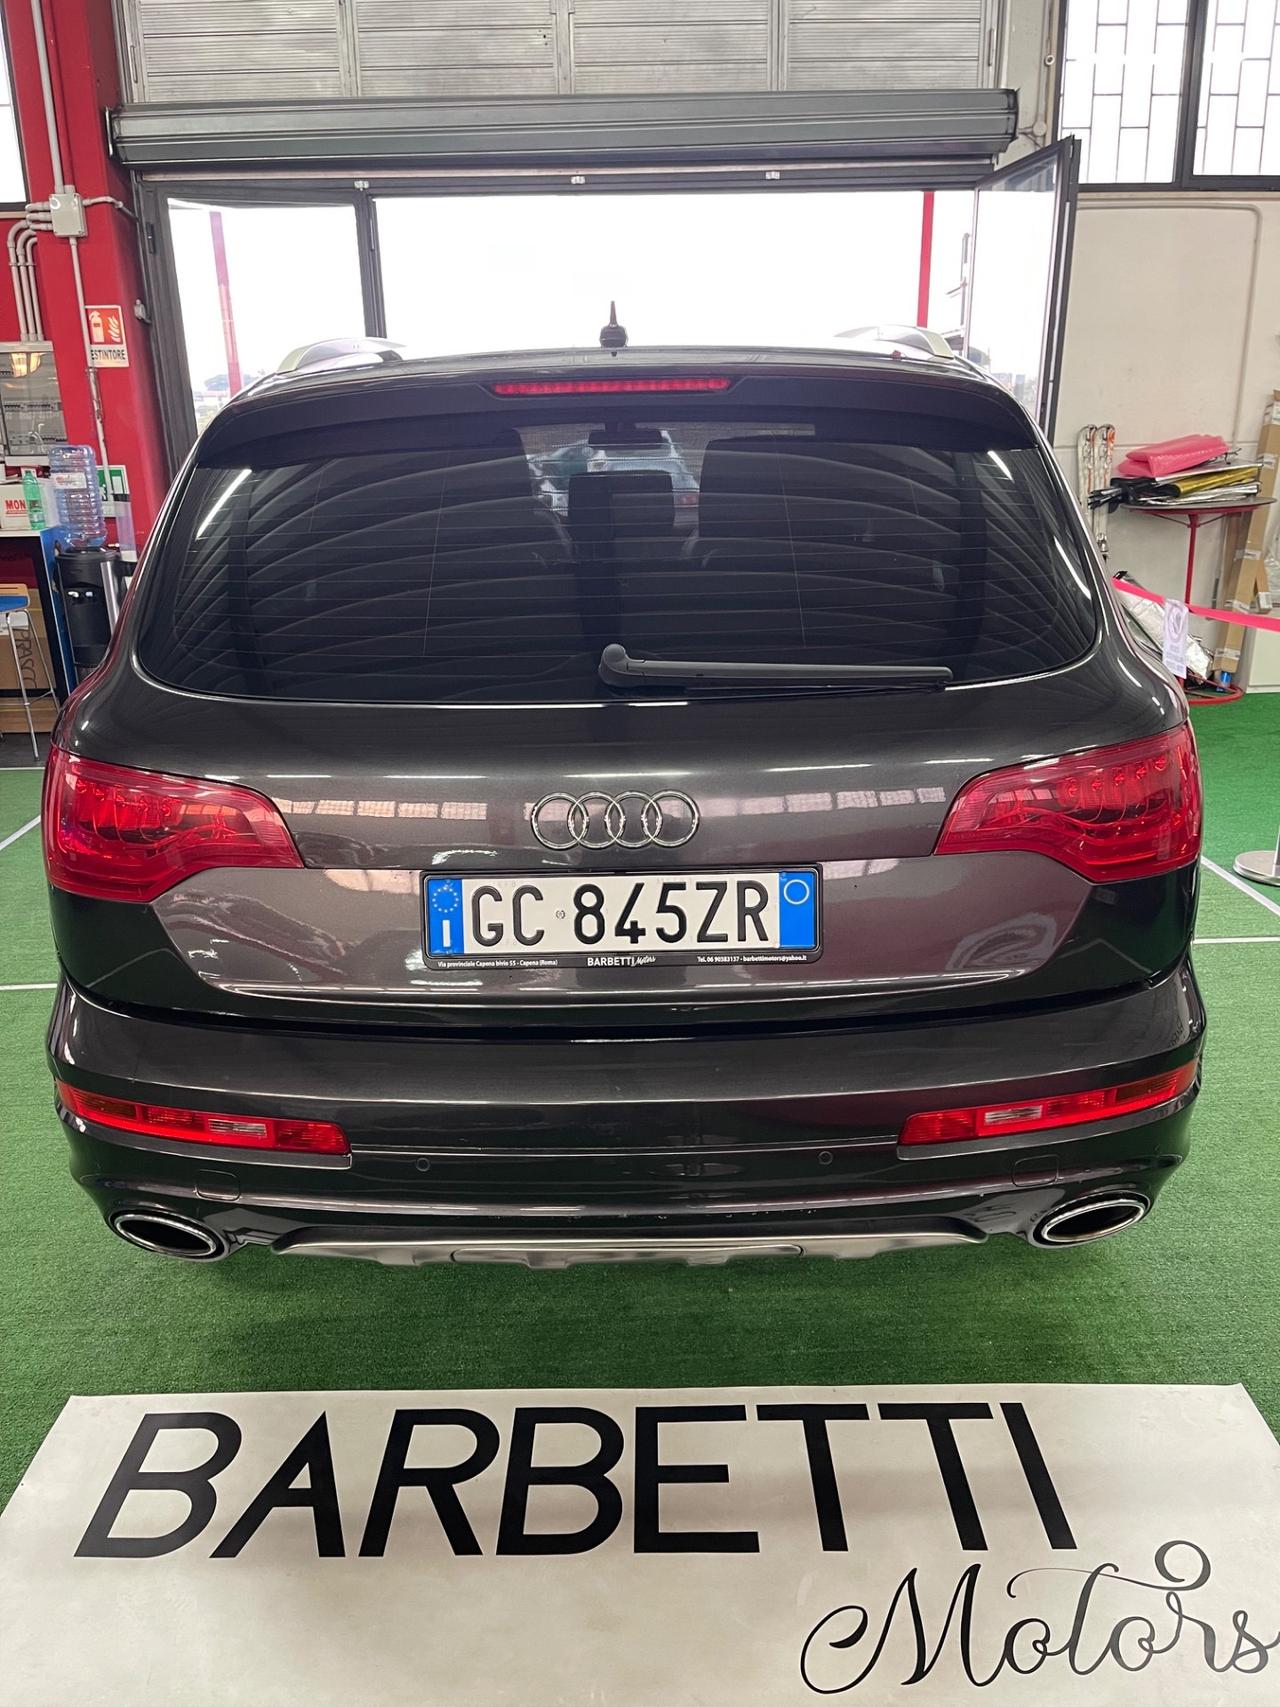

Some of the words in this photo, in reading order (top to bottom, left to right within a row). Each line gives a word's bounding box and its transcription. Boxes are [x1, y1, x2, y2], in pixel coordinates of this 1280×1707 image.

[90, 349, 126, 360] ESTINTORE
[471, 885, 545, 947] GC
[573, 880, 769, 945] 845ZR
[447, 960, 475, 969] provinciale
[476, 960, 495, 968] Capena
[520, 959, 539, 968] Capena
[539, 959, 558, 967] (Roma)
[587, 956, 635, 967] BARBETTI
[74, 1402, 1078, 1558] BARBETTI
[800, 1540, 1280, 1695] Motors
